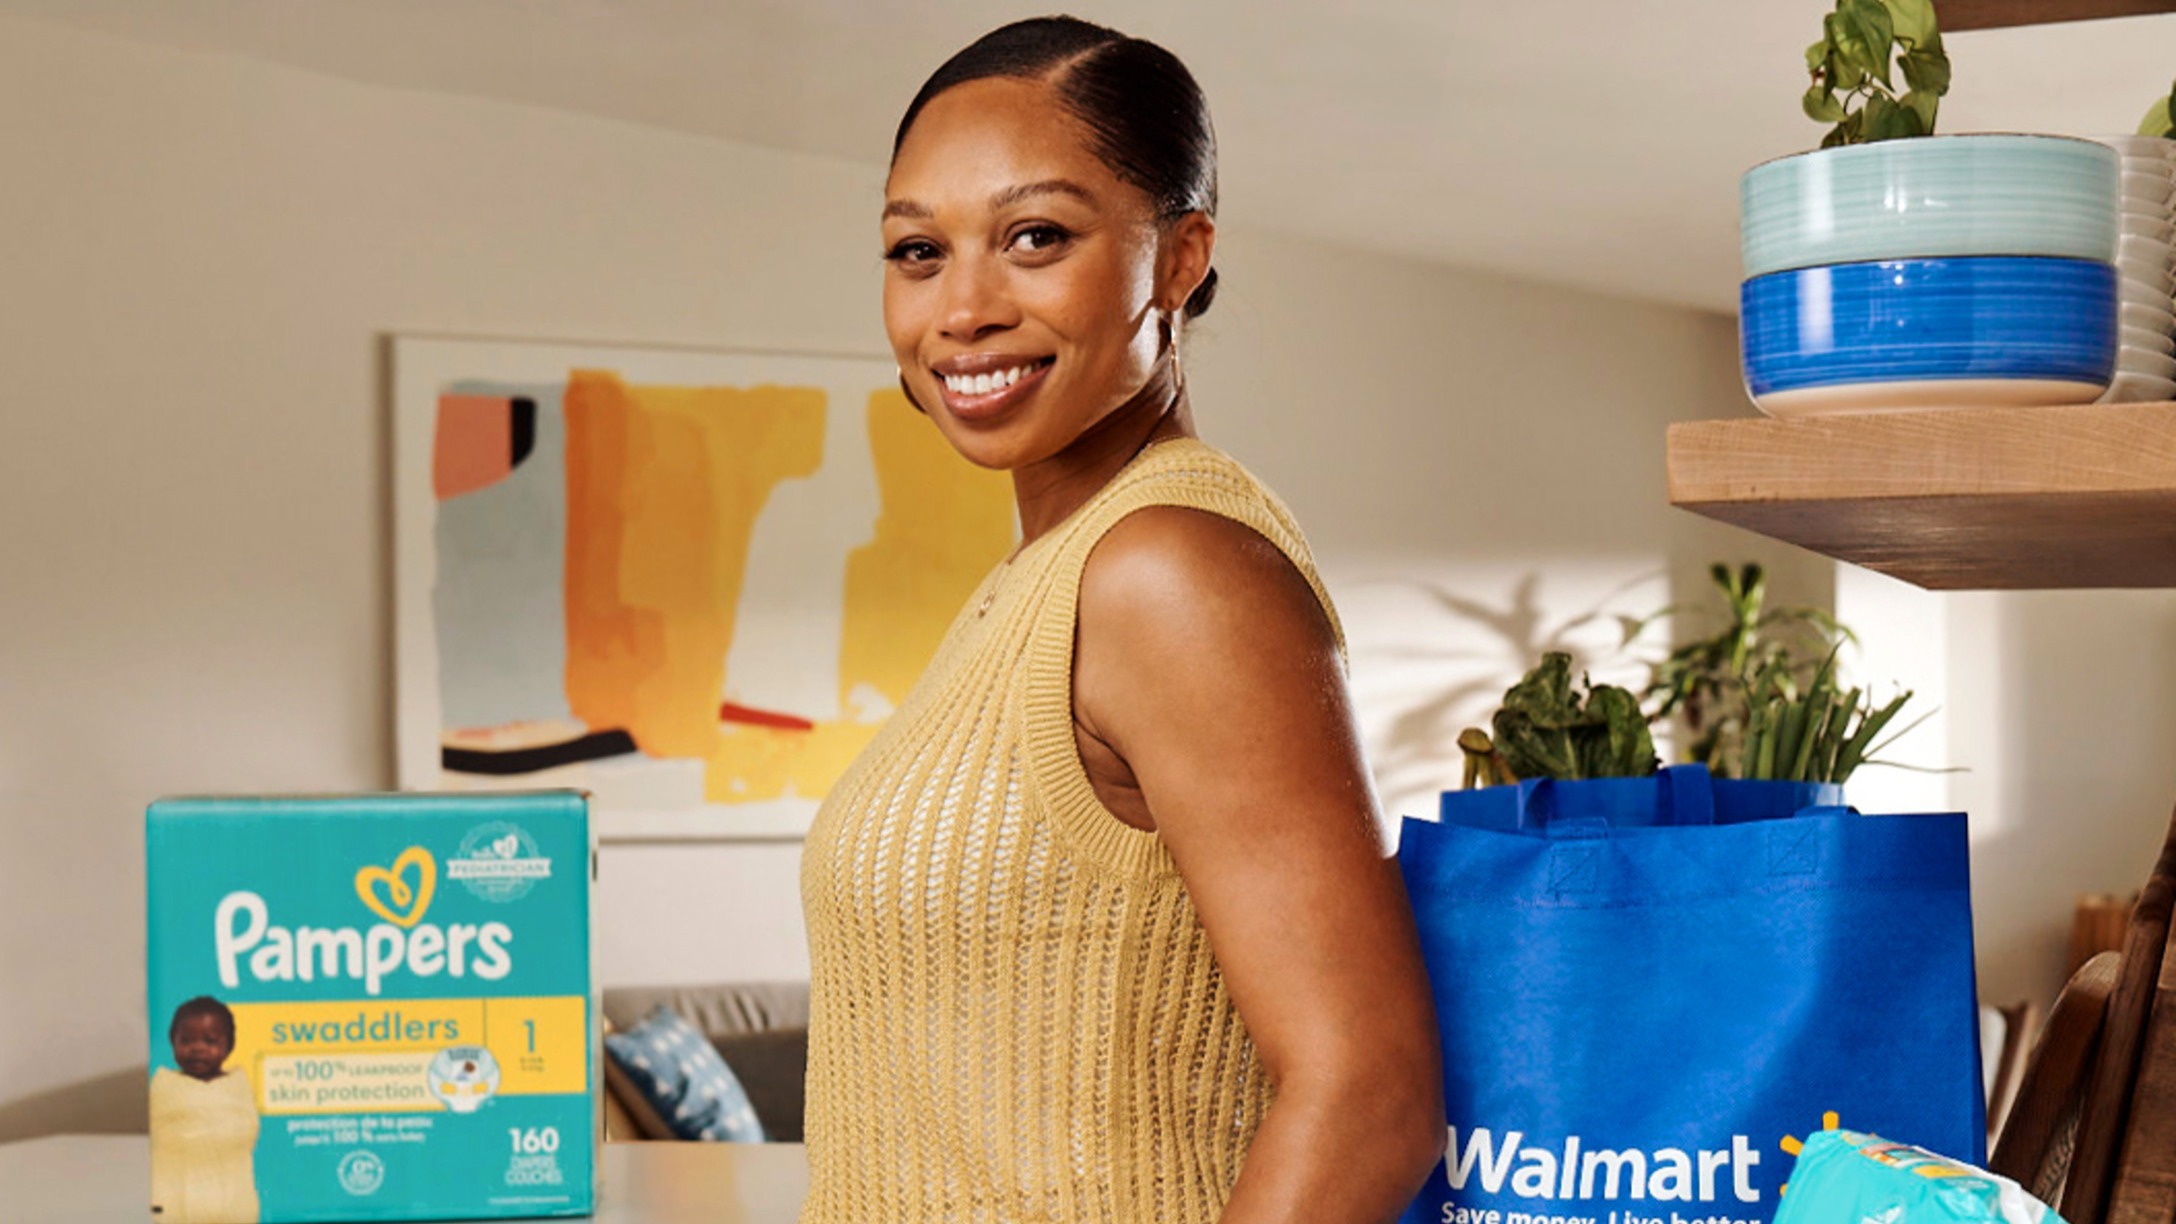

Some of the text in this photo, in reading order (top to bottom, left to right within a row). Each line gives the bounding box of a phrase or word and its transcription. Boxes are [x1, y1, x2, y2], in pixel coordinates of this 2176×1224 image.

[215, 890, 512, 995] Pampers
[272, 1011, 459, 1044] swaddlers
[523, 1019, 535, 1053] 1
[270, 1082, 425, 1106] skin protection
[508, 1126, 560, 1153] 160
[1444, 1125, 1761, 1202] Walmart
[1441, 1202, 1500, 1224] Save
